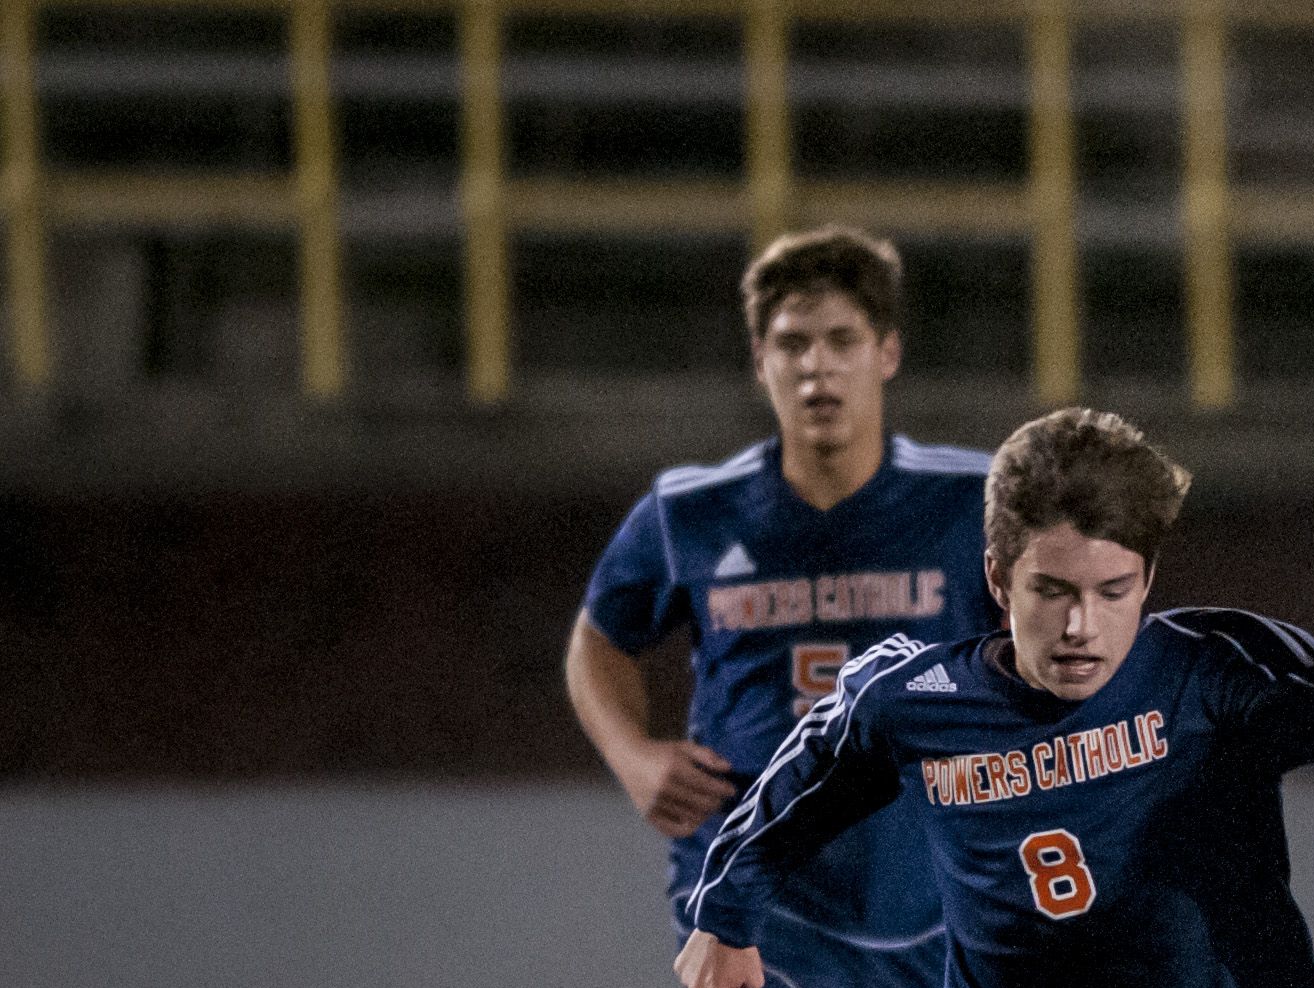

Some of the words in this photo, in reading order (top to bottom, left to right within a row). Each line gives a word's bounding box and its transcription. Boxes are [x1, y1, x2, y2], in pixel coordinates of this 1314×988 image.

[906, 681, 957, 692] adidas
[921, 752, 1031, 805] POWERS
[1032, 710, 1168, 790] CATHOLIC
[1019, 828, 1097, 920] 8
